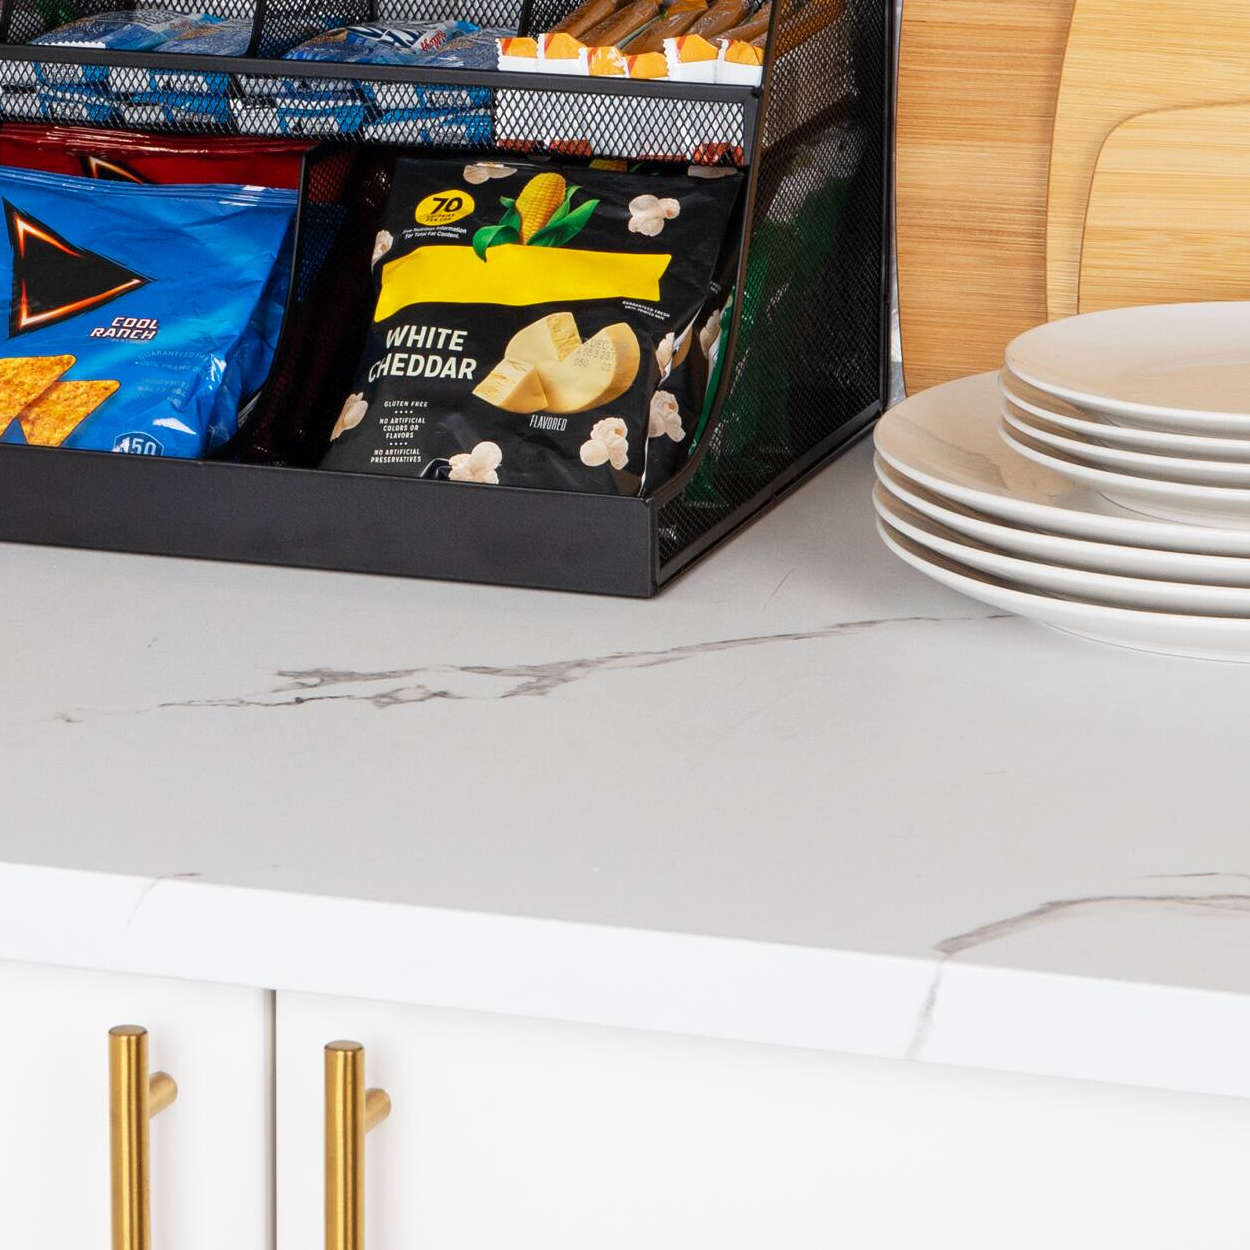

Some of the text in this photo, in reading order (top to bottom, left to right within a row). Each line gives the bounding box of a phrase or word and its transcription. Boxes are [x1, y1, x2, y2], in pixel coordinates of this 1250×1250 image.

[431, 197, 463, 215] 70
[111, 316, 159, 329] COOL
[90, 327, 158, 340] RANCH
[385, 325, 468, 351] WHITE
[590, 338, 610, 350] DEC
[368, 352, 477, 383] CHEDDAR
[384, 400, 409, 408] GLUTEN
[382, 424, 408, 432] COLORS
[529, 414, 568, 431] FLAVORED
[385, 448, 420, 456] ARTIFICIAL
[370, 455, 422, 463] PRESERVATIVES
